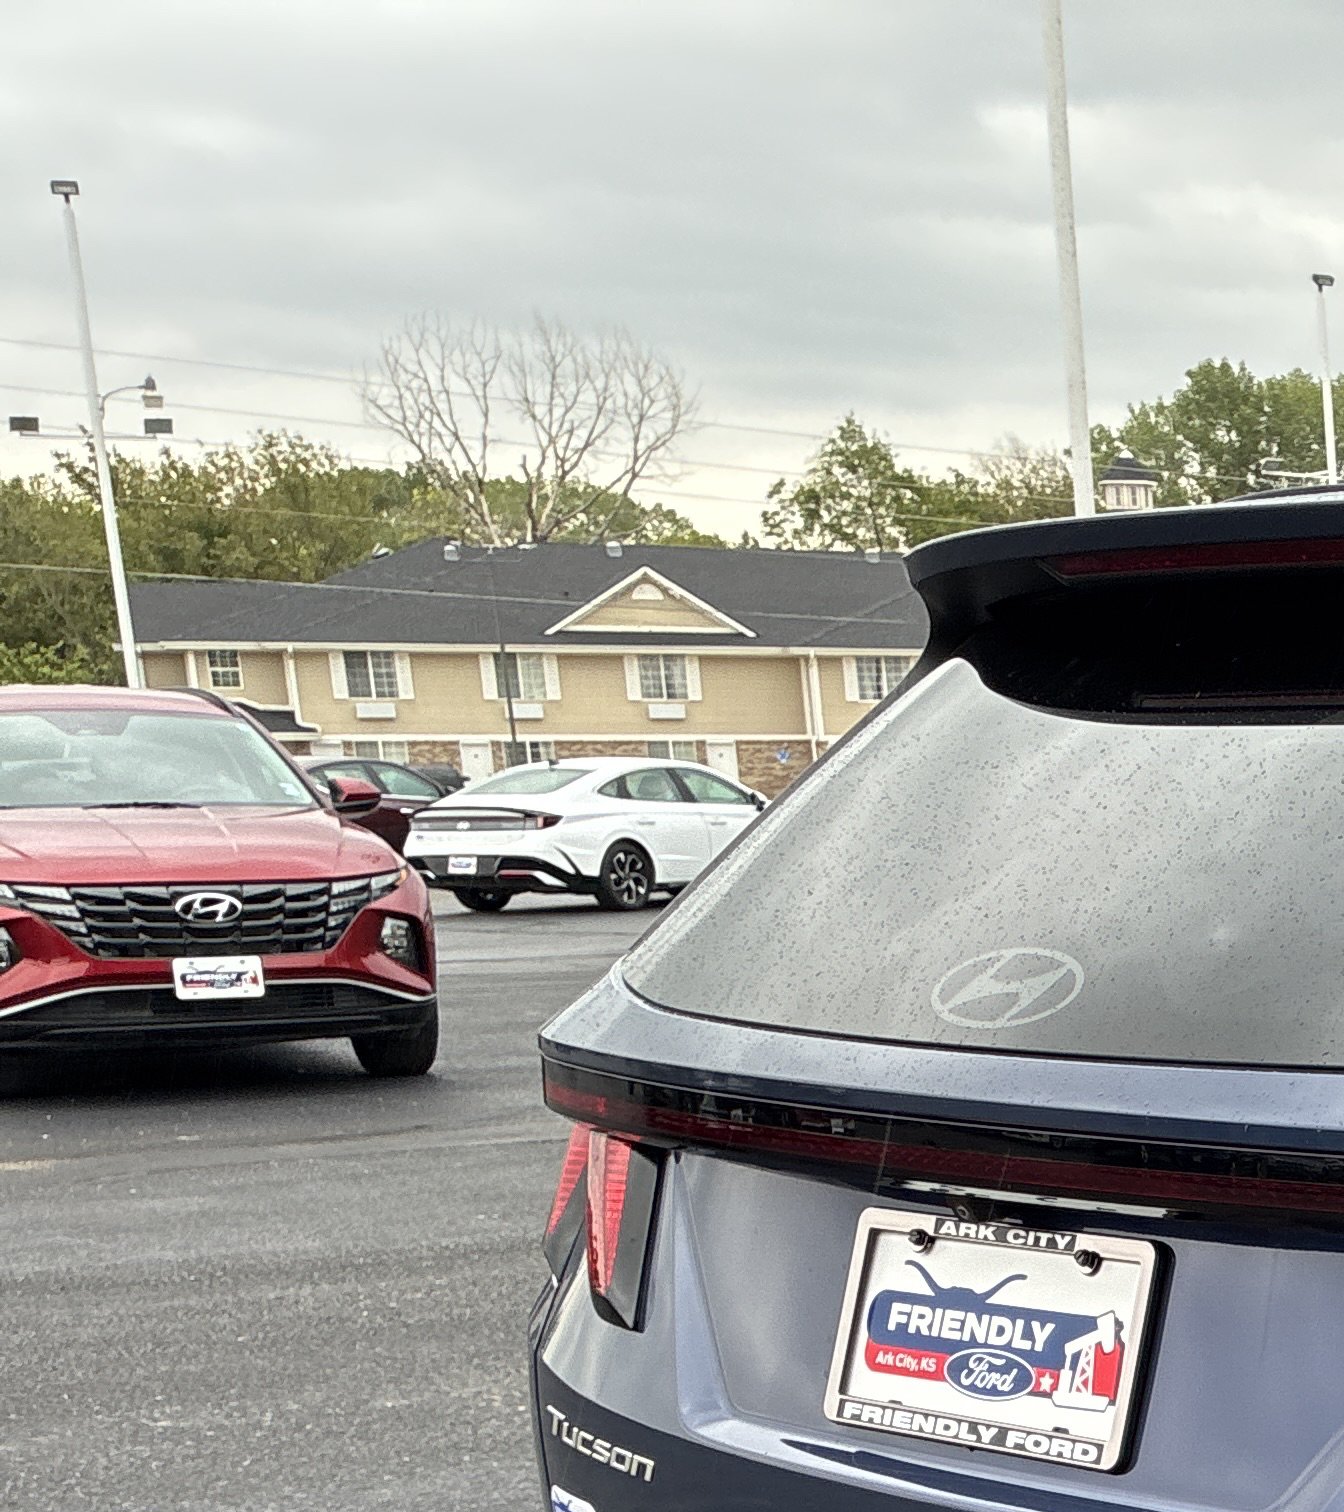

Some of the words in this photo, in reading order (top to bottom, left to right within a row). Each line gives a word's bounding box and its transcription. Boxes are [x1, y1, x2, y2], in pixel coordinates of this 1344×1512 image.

[937, 1220, 998, 1241] ARK
[1006, 1230, 1075, 1250] CITY
[887, 1302, 1056, 1352] FRIENDLY
[875, 1351, 895, 1367] Ark
[896, 1353, 920, 1371] City,
[920, 1357, 937, 1373] KS
[960, 1353, 1016, 1392] Ford
[842, 1405, 998, 1444] FRIENDLY
[1005, 1431, 1099, 1462] FORD
